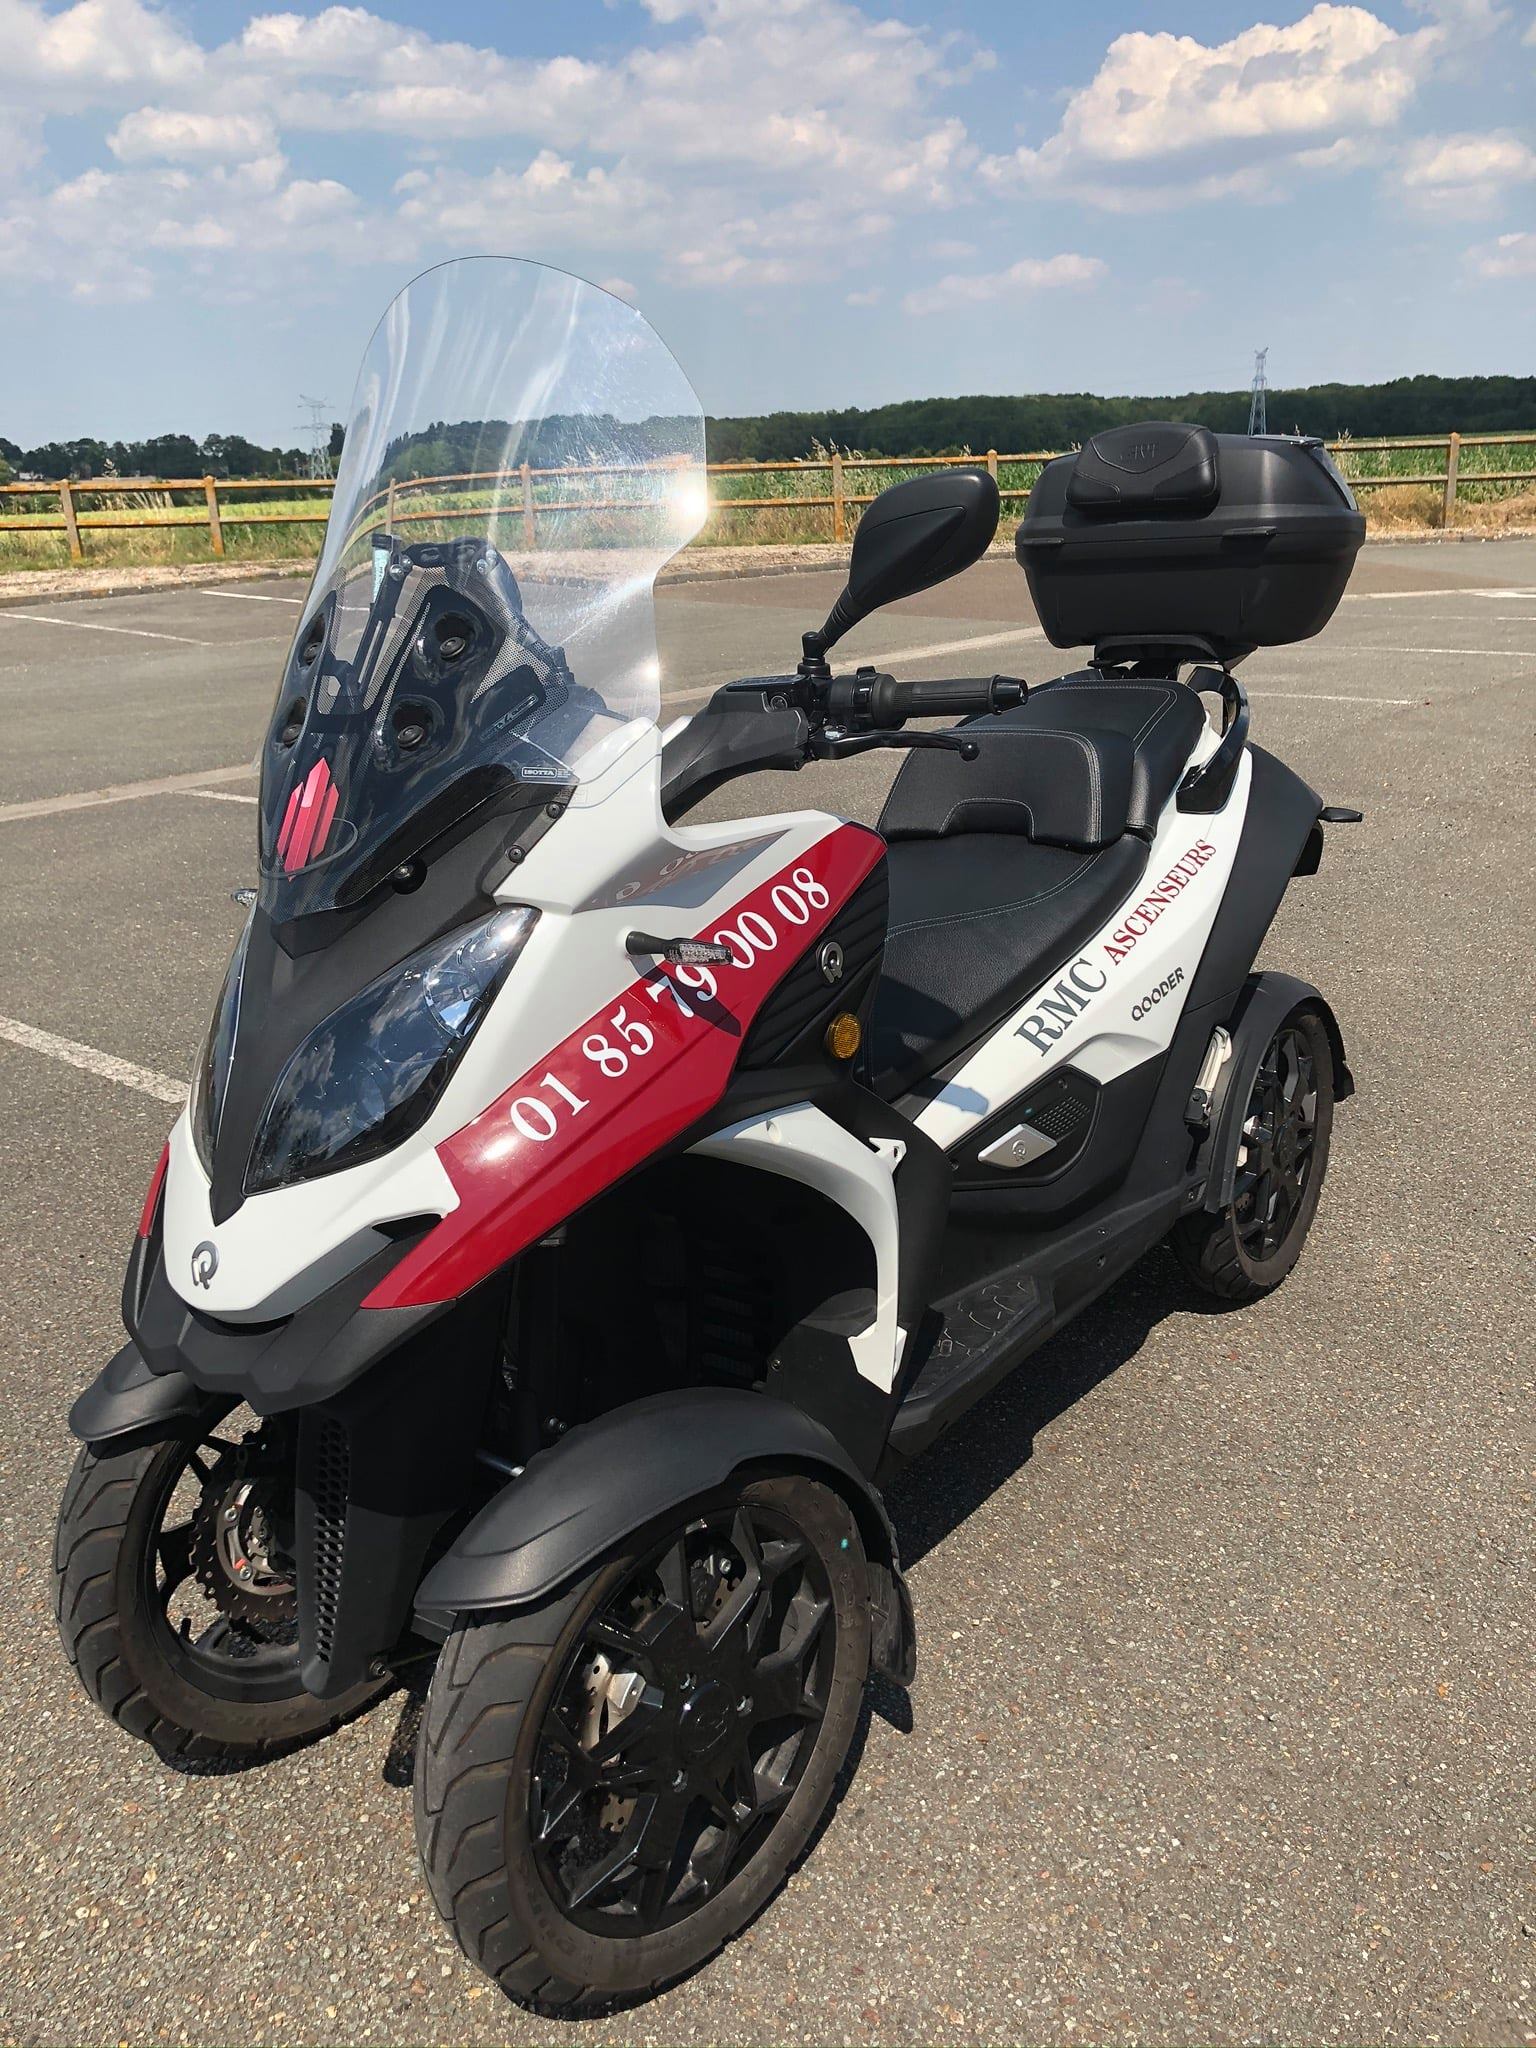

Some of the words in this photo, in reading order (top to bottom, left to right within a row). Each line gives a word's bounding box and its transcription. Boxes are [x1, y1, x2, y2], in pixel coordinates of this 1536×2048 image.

[510, 1072, 590, 1142] 01
[582, 1005, 654, 1078] 85
[645, 965, 718, 1018] 79
[713, 911, 777, 969] 00
[771, 867, 830, 926] 08
[1013, 957, 1107, 1057] RMC
[1103, 839, 1217, 965] ASCENSEURS
[1131, 966, 1185, 1021] QOODER
